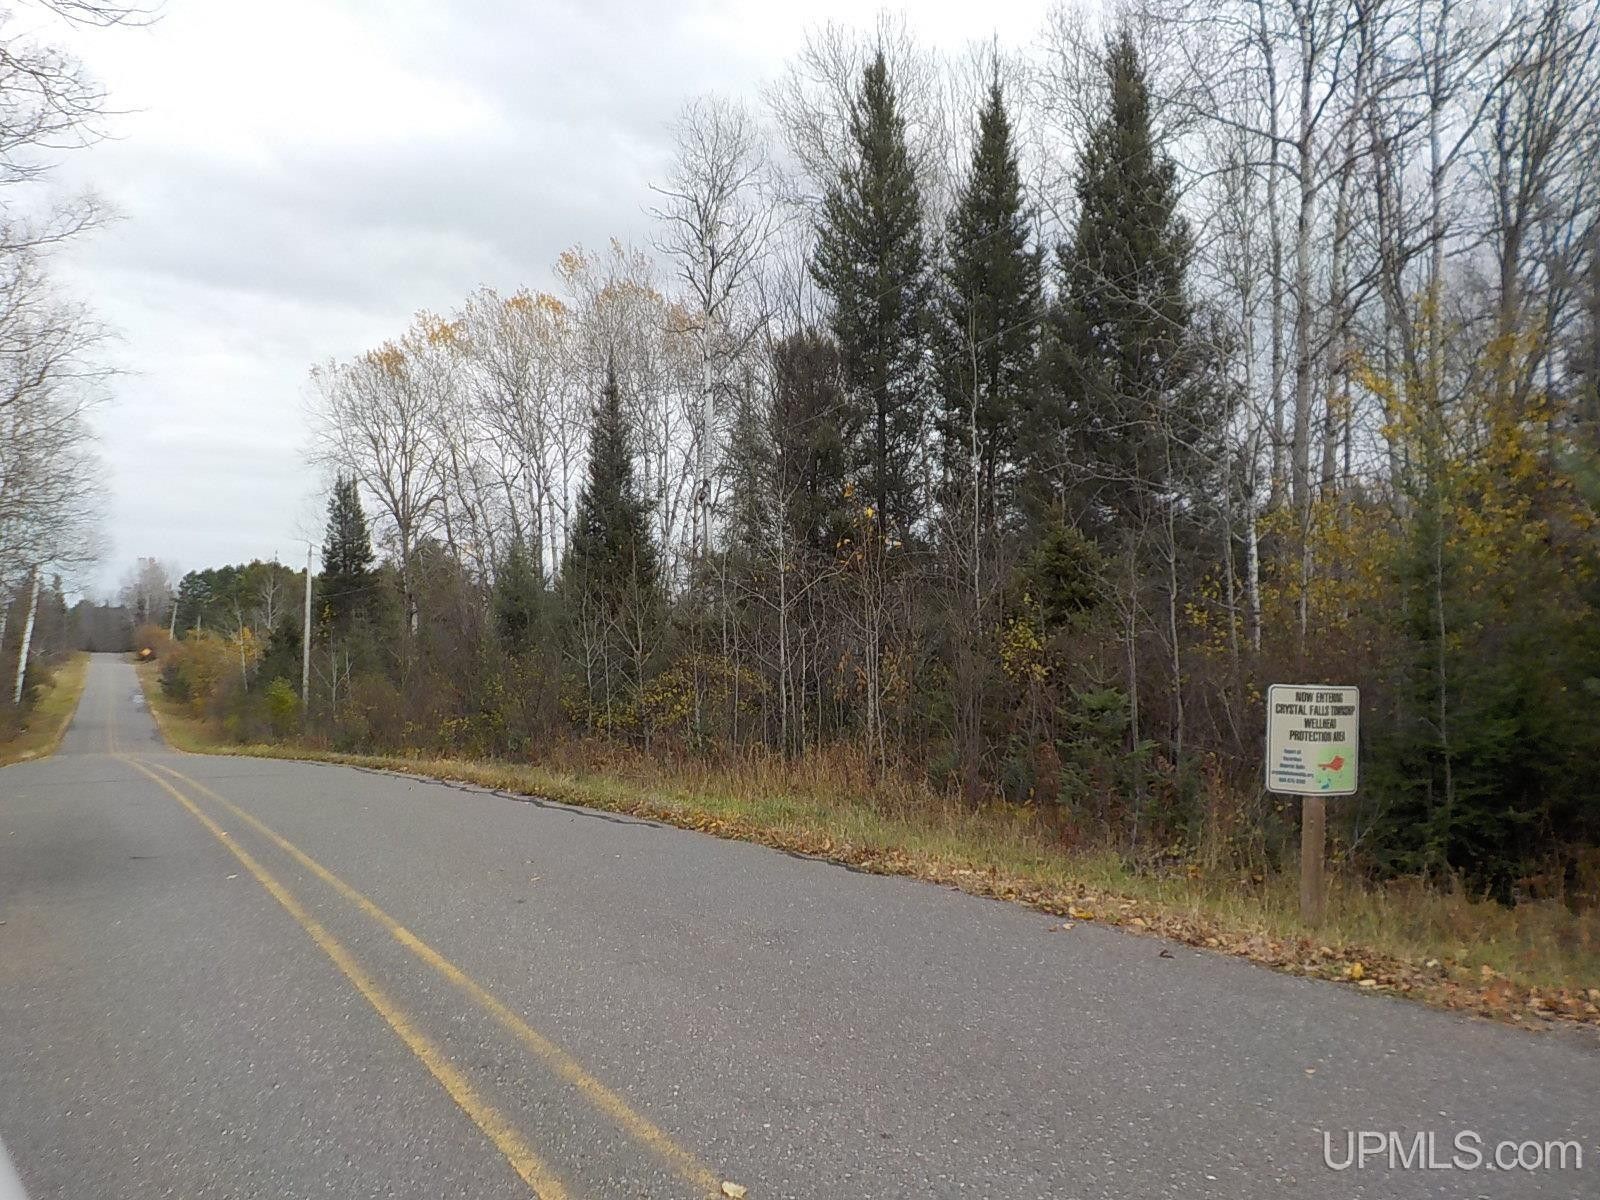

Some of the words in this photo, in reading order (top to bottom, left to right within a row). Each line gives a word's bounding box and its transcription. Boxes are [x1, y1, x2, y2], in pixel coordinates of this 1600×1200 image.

[1296, 691, 1314, 703] NOW
[1275, 703, 1307, 716] CRYSTAL
[1309, 705, 1329, 716] FALLS
[1289, 730, 1331, 741] PROTECTION
